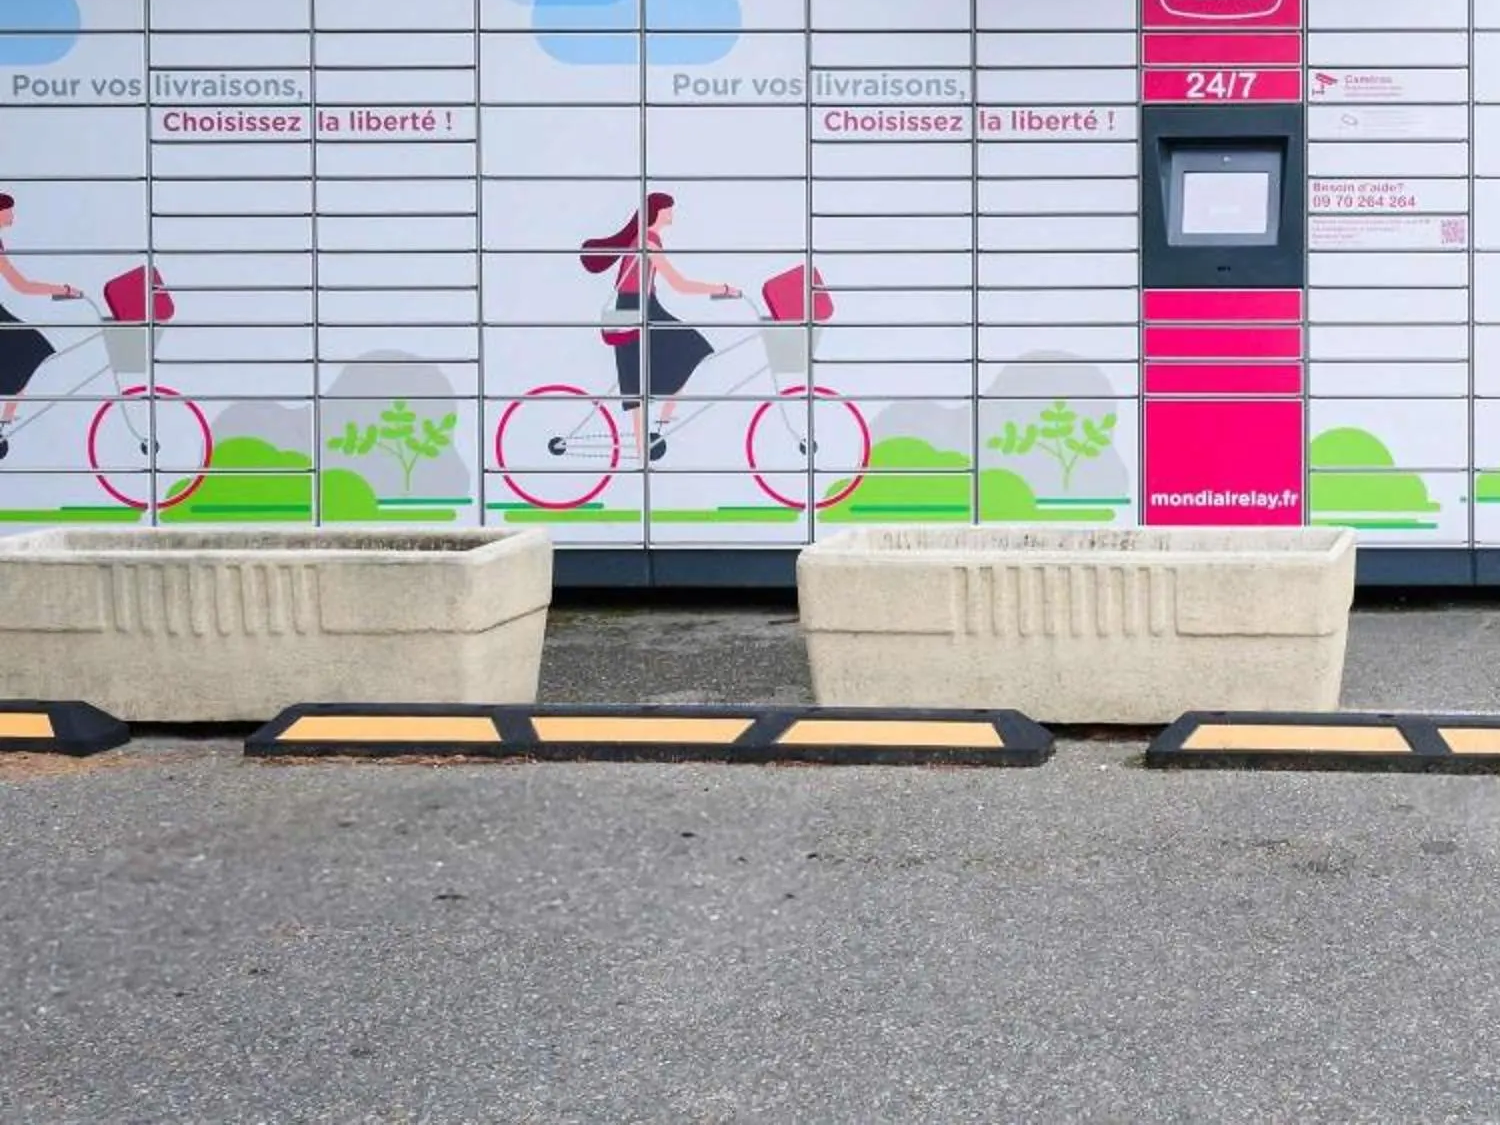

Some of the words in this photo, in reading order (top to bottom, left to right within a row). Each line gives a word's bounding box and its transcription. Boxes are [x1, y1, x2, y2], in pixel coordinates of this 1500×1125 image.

[12, 74, 80, 96] Pour
[91, 79, 142, 96] vos
[155, 74, 304, 101] livraisons,
[673, 75, 741, 97] Pour
[753, 79, 803, 97] vos
[816, 74, 966, 101] livraisons,
[1185, 72, 1257, 98] 24/7
[163, 111, 301, 133] Choisissez
[318, 111, 340, 132] la
[350, 110, 436, 132] liberté
[446, 112, 452, 132] !
[824, 110, 963, 133] Choisissez
[979, 111, 1001, 132] la
[1012, 110, 1098, 132] liberté
[1108, 112, 1114, 132] !
[1312, 194, 1331, 208] 09
[1336, 194, 1353, 208] 70
[1357, 194, 1384, 208] 264
[1389, 194, 1416, 208] 264
[1150, 490, 1299, 509] mondialrelay.fr
